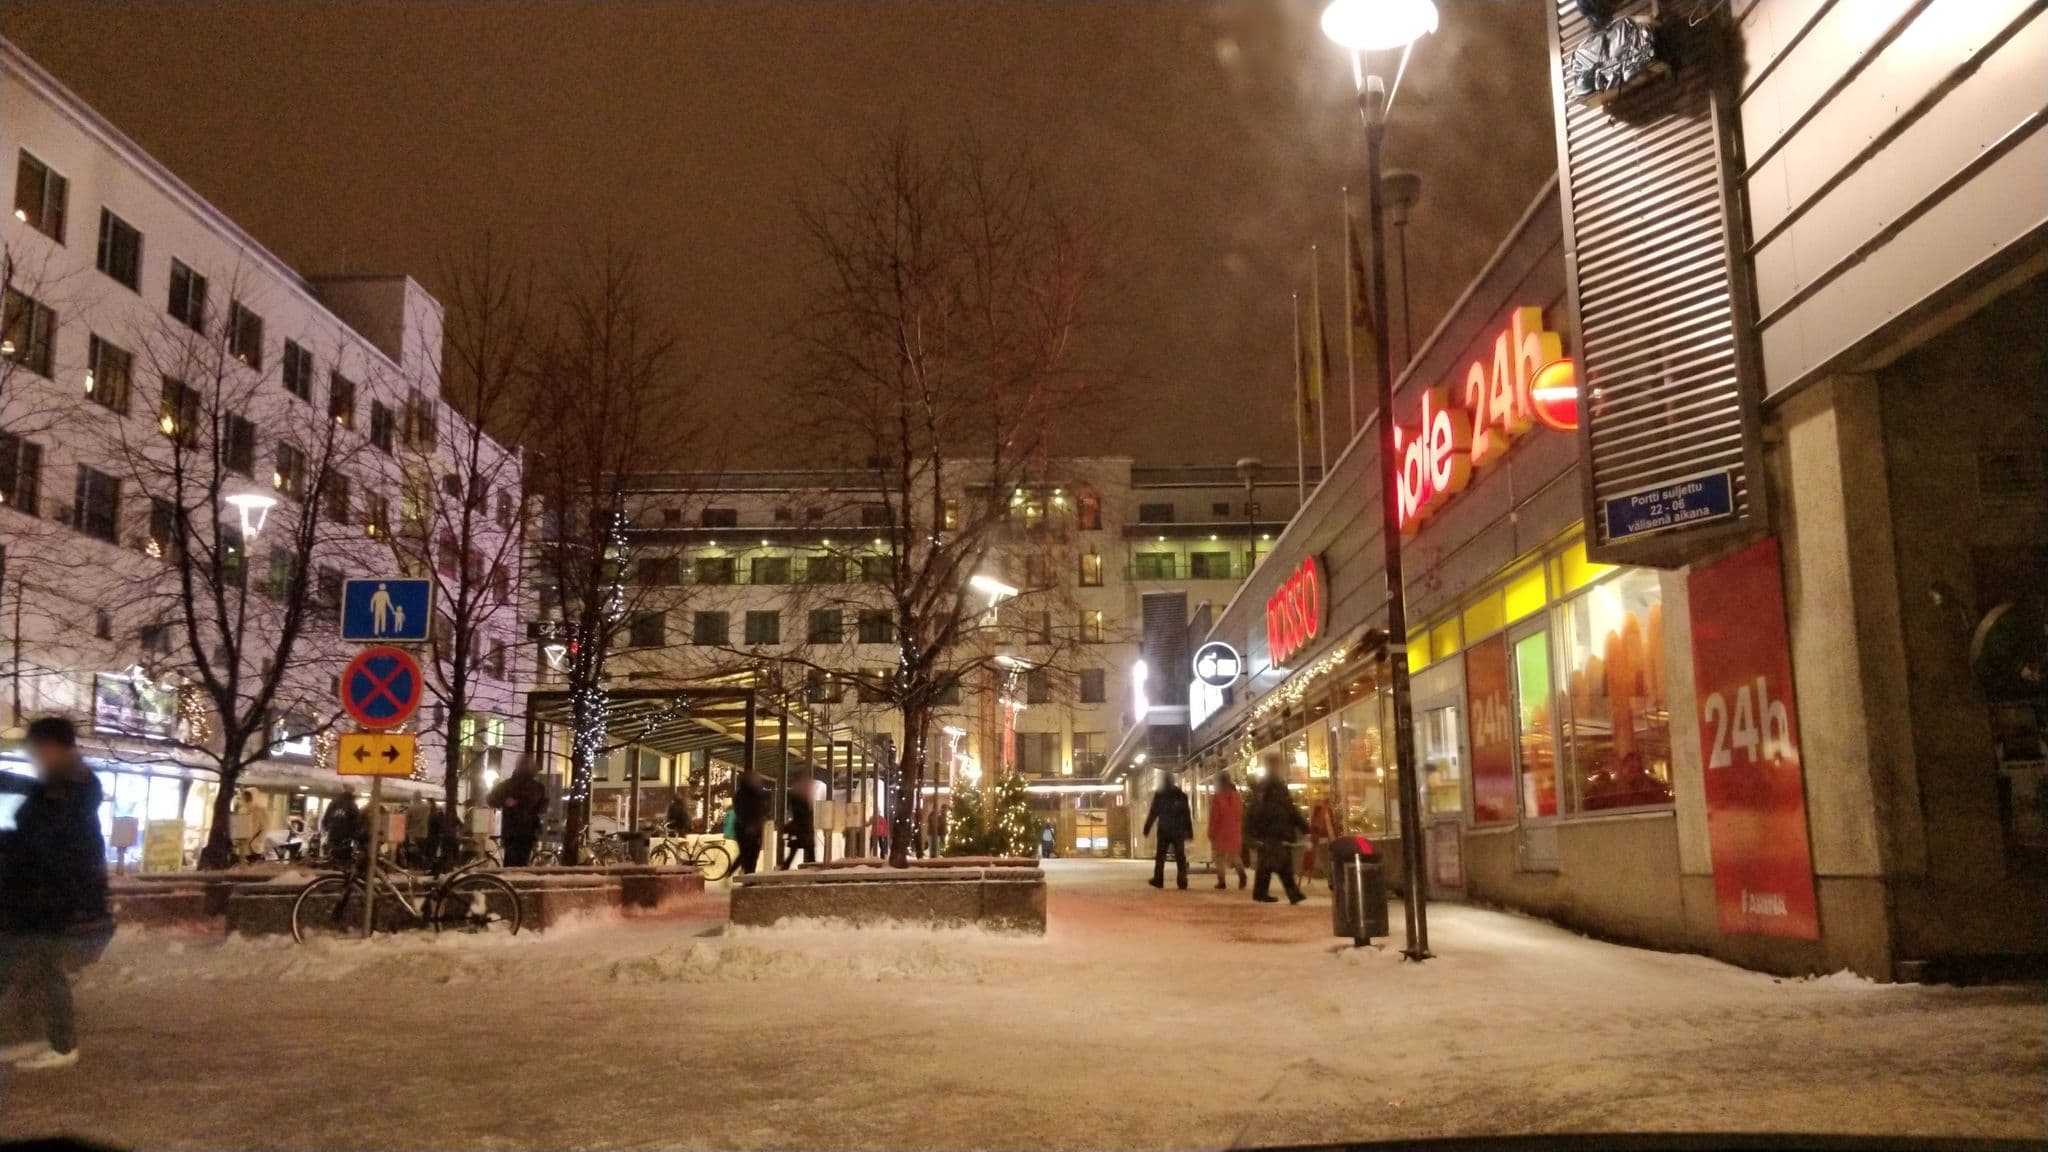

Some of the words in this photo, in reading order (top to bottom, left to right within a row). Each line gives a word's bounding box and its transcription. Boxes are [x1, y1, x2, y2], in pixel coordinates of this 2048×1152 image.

[1465, 306, 1546, 467] 24h
[1631, 491, 1660, 507] Portti
[1662, 483, 1702, 498] suljettu
[1650, 503, 1664, 516] 22
[1671, 499, 1685, 511] 06
[1674, 506, 1710, 524] aikana
[1266, 555, 1318, 668] ROSSO
[1471, 690, 1509, 747] 24h
[1704, 675, 1800, 770] 24h
